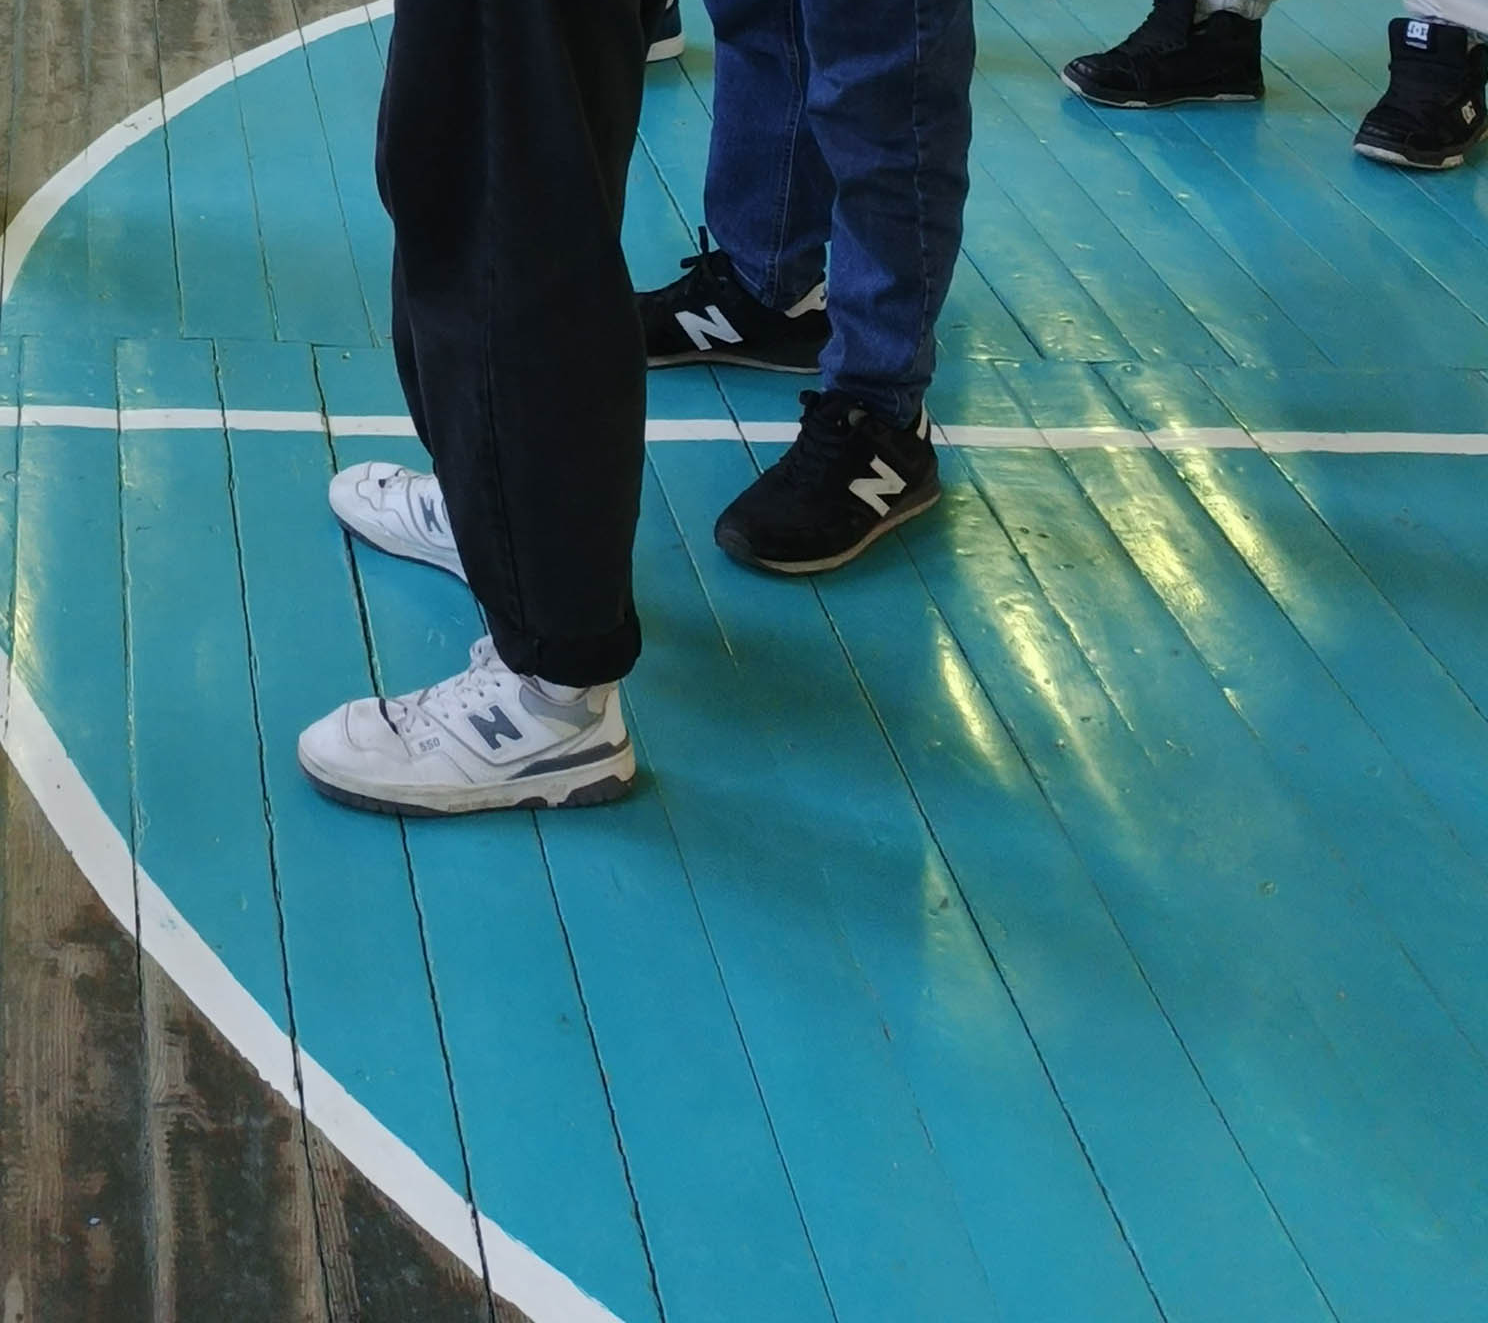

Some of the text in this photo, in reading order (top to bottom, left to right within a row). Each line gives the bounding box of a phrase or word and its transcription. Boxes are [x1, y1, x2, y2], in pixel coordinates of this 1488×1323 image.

[674, 305, 743, 351] N
[848, 455, 907, 517] N
[418, 737, 441, 752] 550
[468, 705, 523, 750] N
